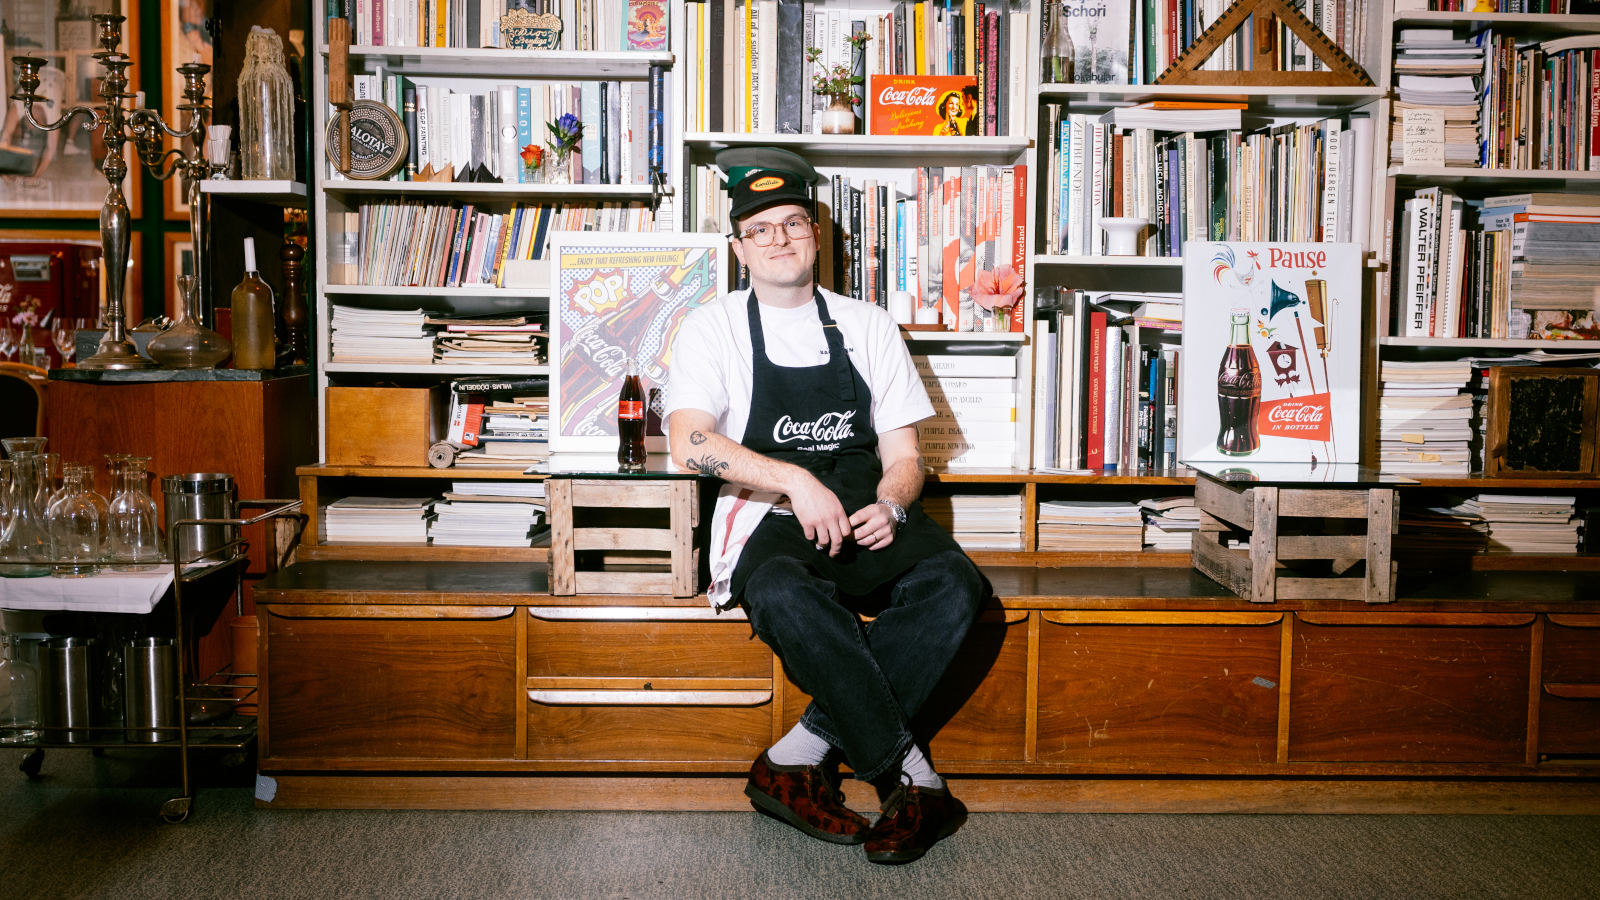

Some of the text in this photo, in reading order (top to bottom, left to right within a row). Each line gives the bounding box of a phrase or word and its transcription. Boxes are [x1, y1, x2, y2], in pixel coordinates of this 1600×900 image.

[1063, 5, 1106, 17] Schori
[1074, 73, 1115, 81] okabular
[879, 86, 937, 106] Coca-Cola
[519, 94, 528, 135] LÜTHI
[350, 126, 390, 153] ALOTAY
[1072, 122, 1083, 195] ZEITBLENDE
[1328, 162, 1336, 204] JUERGEN
[595, 257, 608, 265] THAT
[609, 255, 641, 264] REFRESHING
[1268, 248, 1326, 269] Pause
[1414, 207, 1428, 329] WALTER PFEIFFER
[1014, 226, 1026, 324] Allure Vreeland
[577, 269, 629, 314] POP!
[773, 409, 856, 443] Coca-Cola
[1268, 405, 1325, 422] Coca-Cola
[817, 443, 840, 451] Magic
